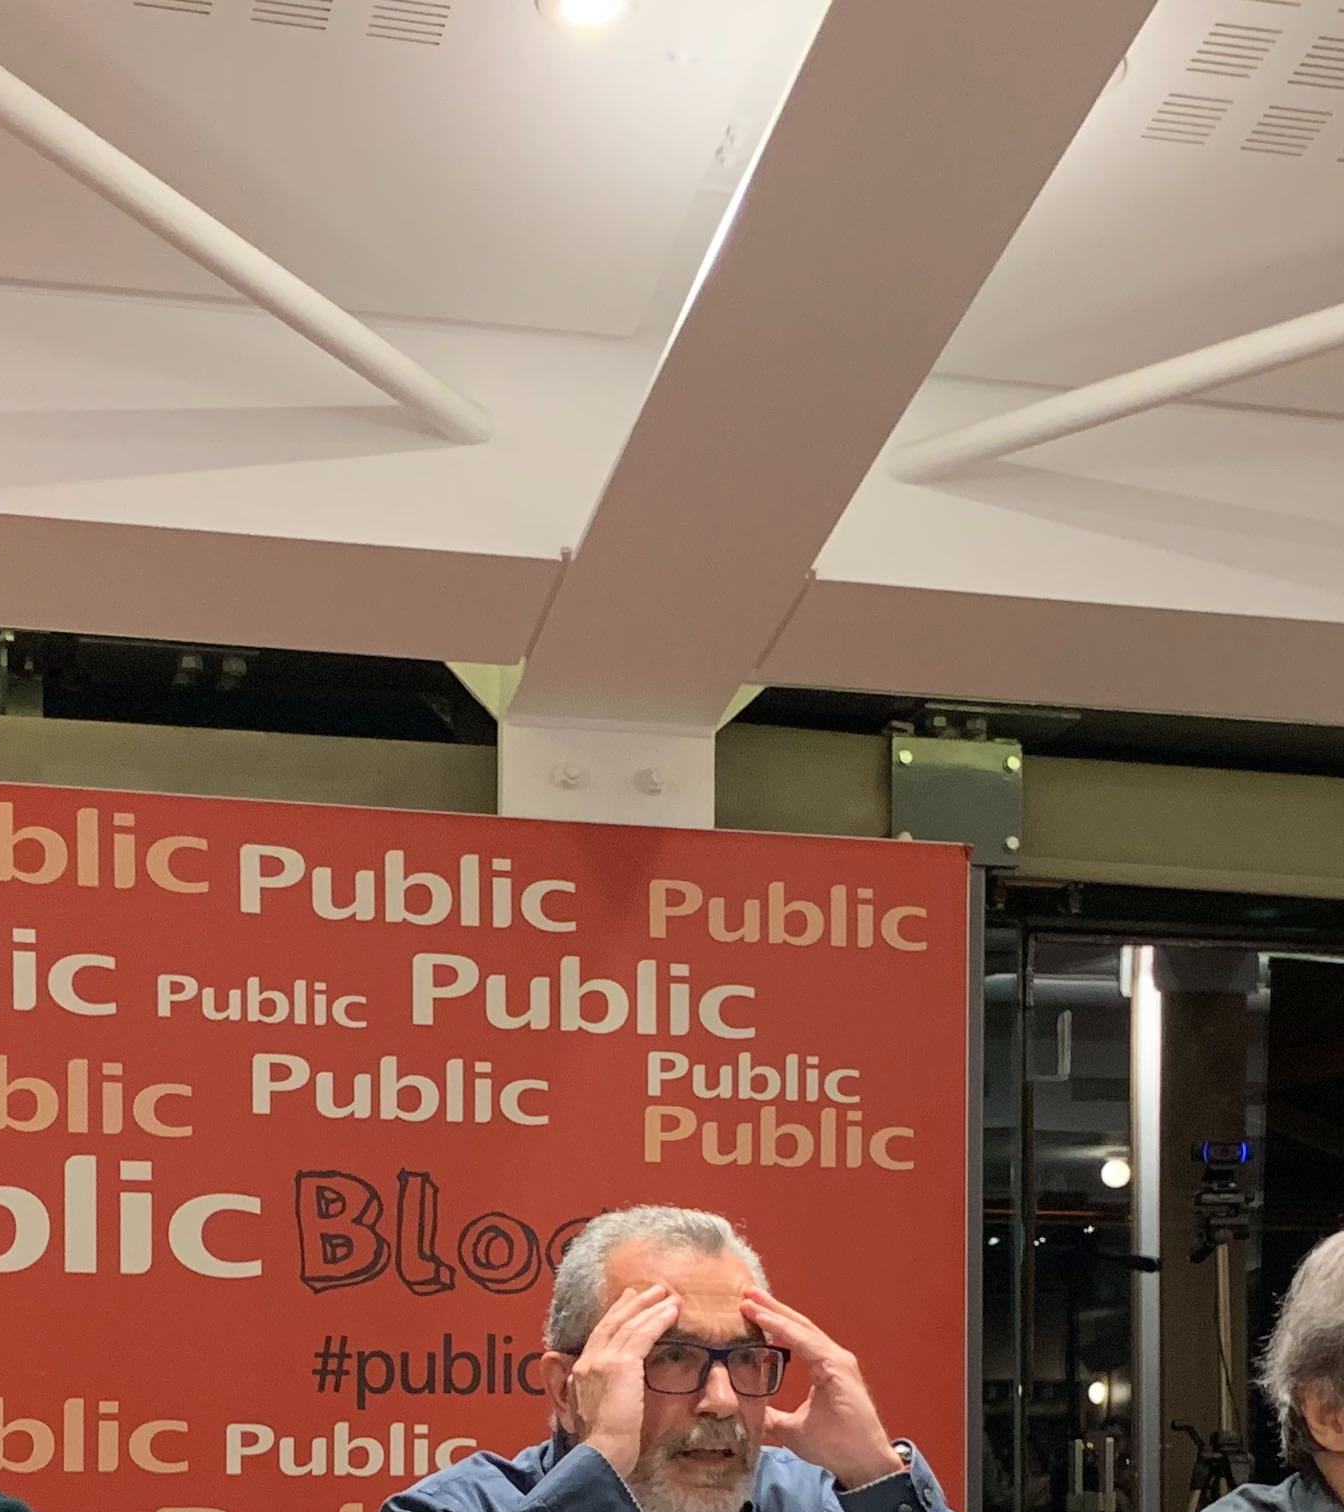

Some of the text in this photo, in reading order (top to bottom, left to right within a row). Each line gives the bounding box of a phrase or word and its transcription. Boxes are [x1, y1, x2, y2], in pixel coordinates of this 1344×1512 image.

[239, 843, 577, 933] Public
[649, 879, 928, 952] Public
[156, 973, 368, 1029] Public
[411, 952, 756, 1040] Public
[251, 1052, 550, 1126] Public
[647, 1050, 861, 1104] Public
[644, 1104, 915, 1171] Public
[225, 1421, 478, 1478] Public
